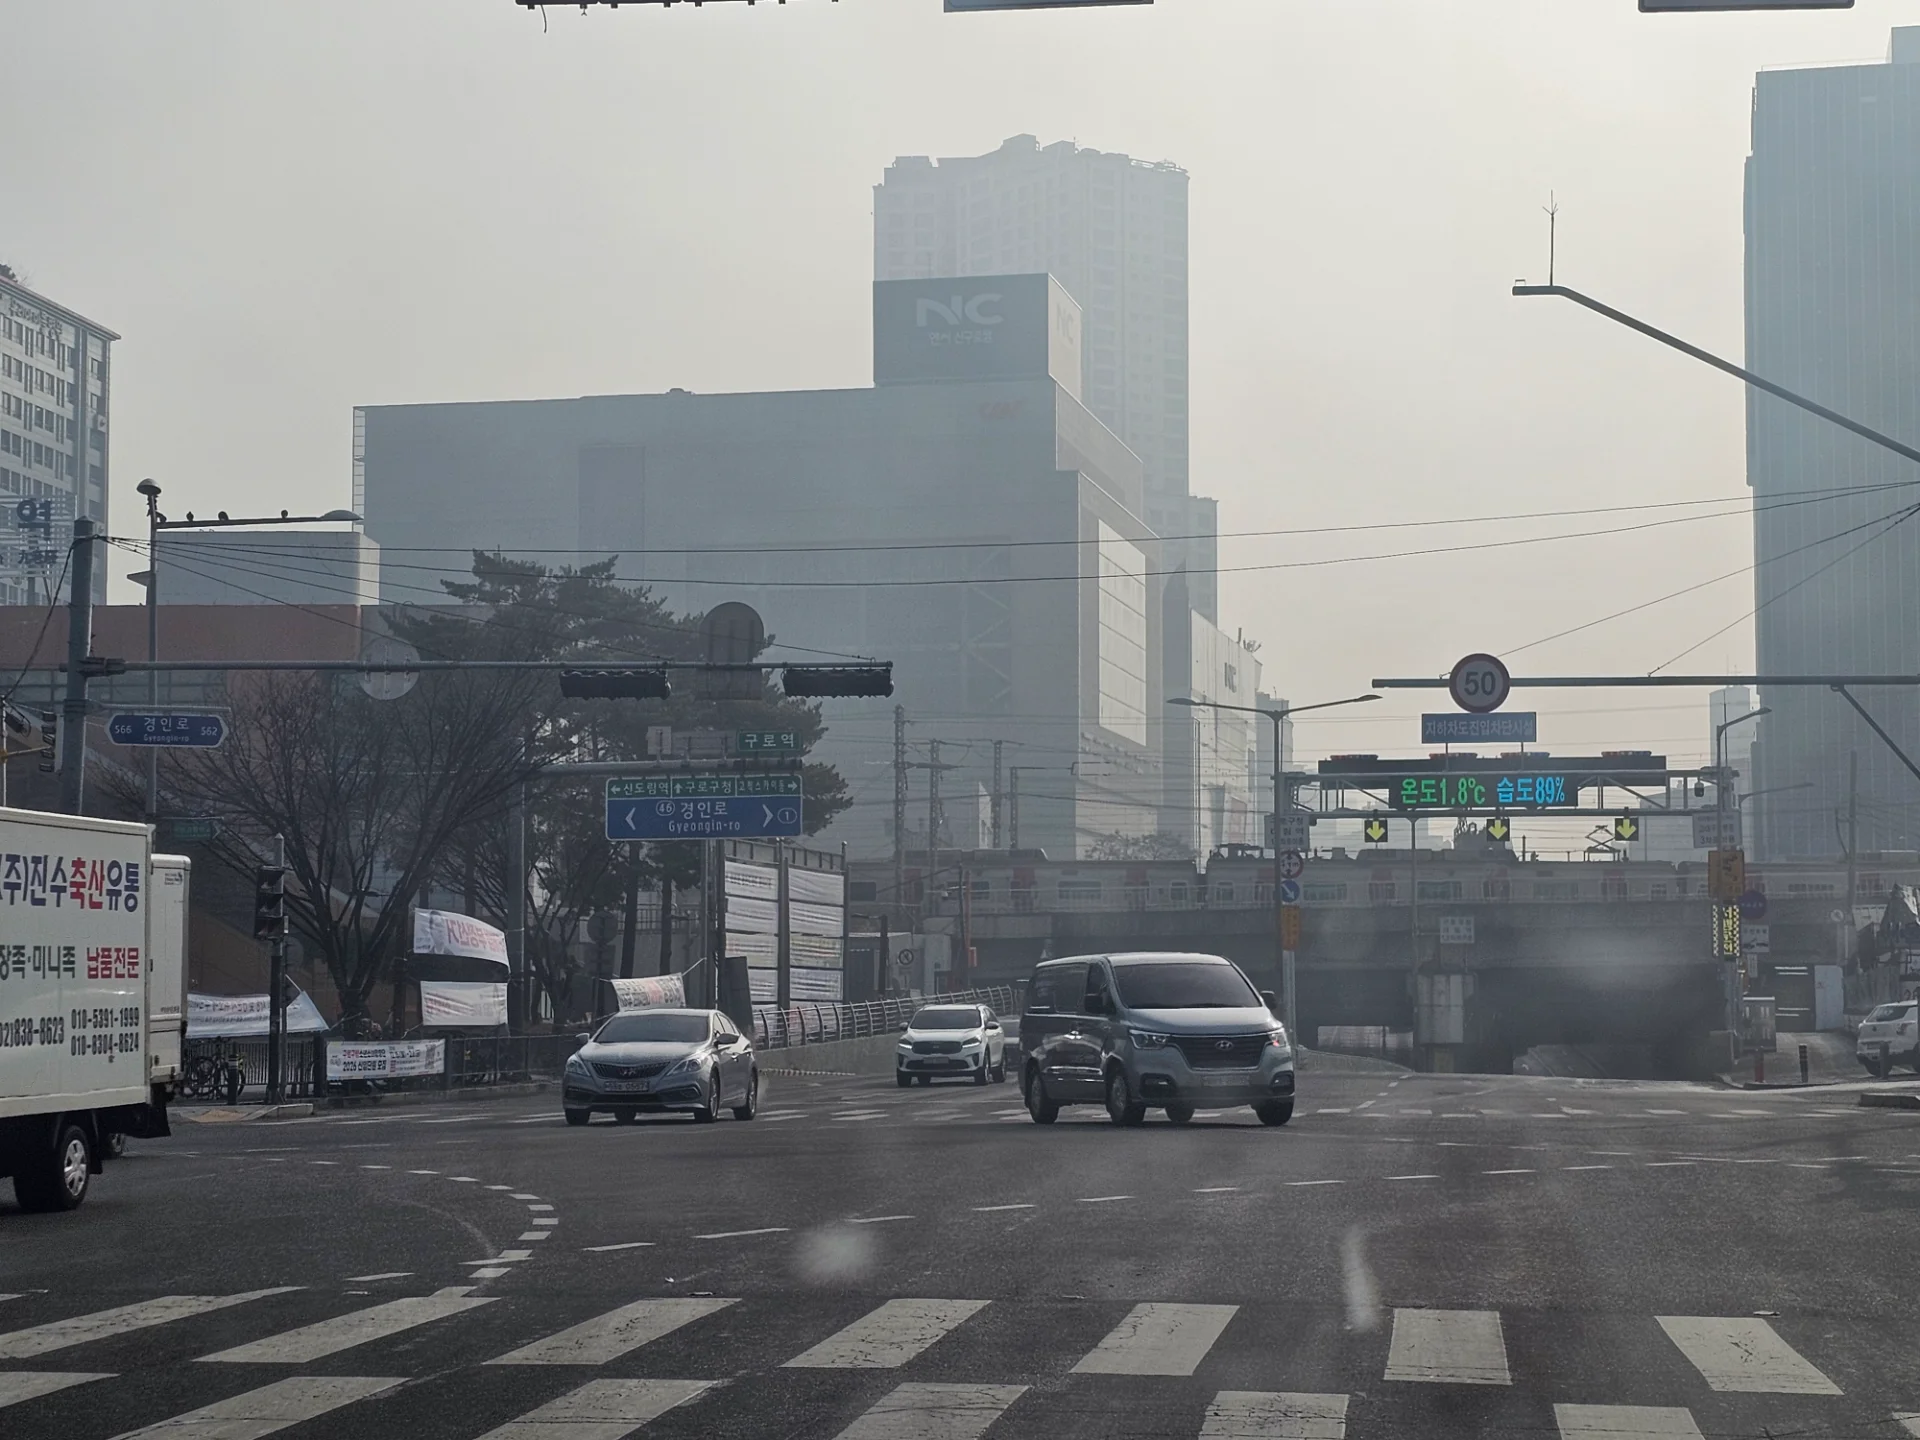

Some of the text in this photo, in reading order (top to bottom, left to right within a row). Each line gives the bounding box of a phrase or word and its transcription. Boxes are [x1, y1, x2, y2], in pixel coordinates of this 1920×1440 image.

[916, 293, 1004, 328] NC
[1463, 671, 1496, 696] 50
[114, 725, 132, 734] 566
[143, 717, 190, 732] 경인로
[201, 726, 218, 736] 562
[744, 733, 794, 748] 구로역
[623, 782, 669, 796] 신도림역
[686, 780, 732, 794] 구로구청
[1496, 777, 1565, 804] 습도89%
[680, 801, 728, 820] 경인로
[668, 820, 741, 834] Gyeongin-ro
[86, 946, 140, 980] 납품전문
[71, 1006, 140, 1030] 010-5391-1999
